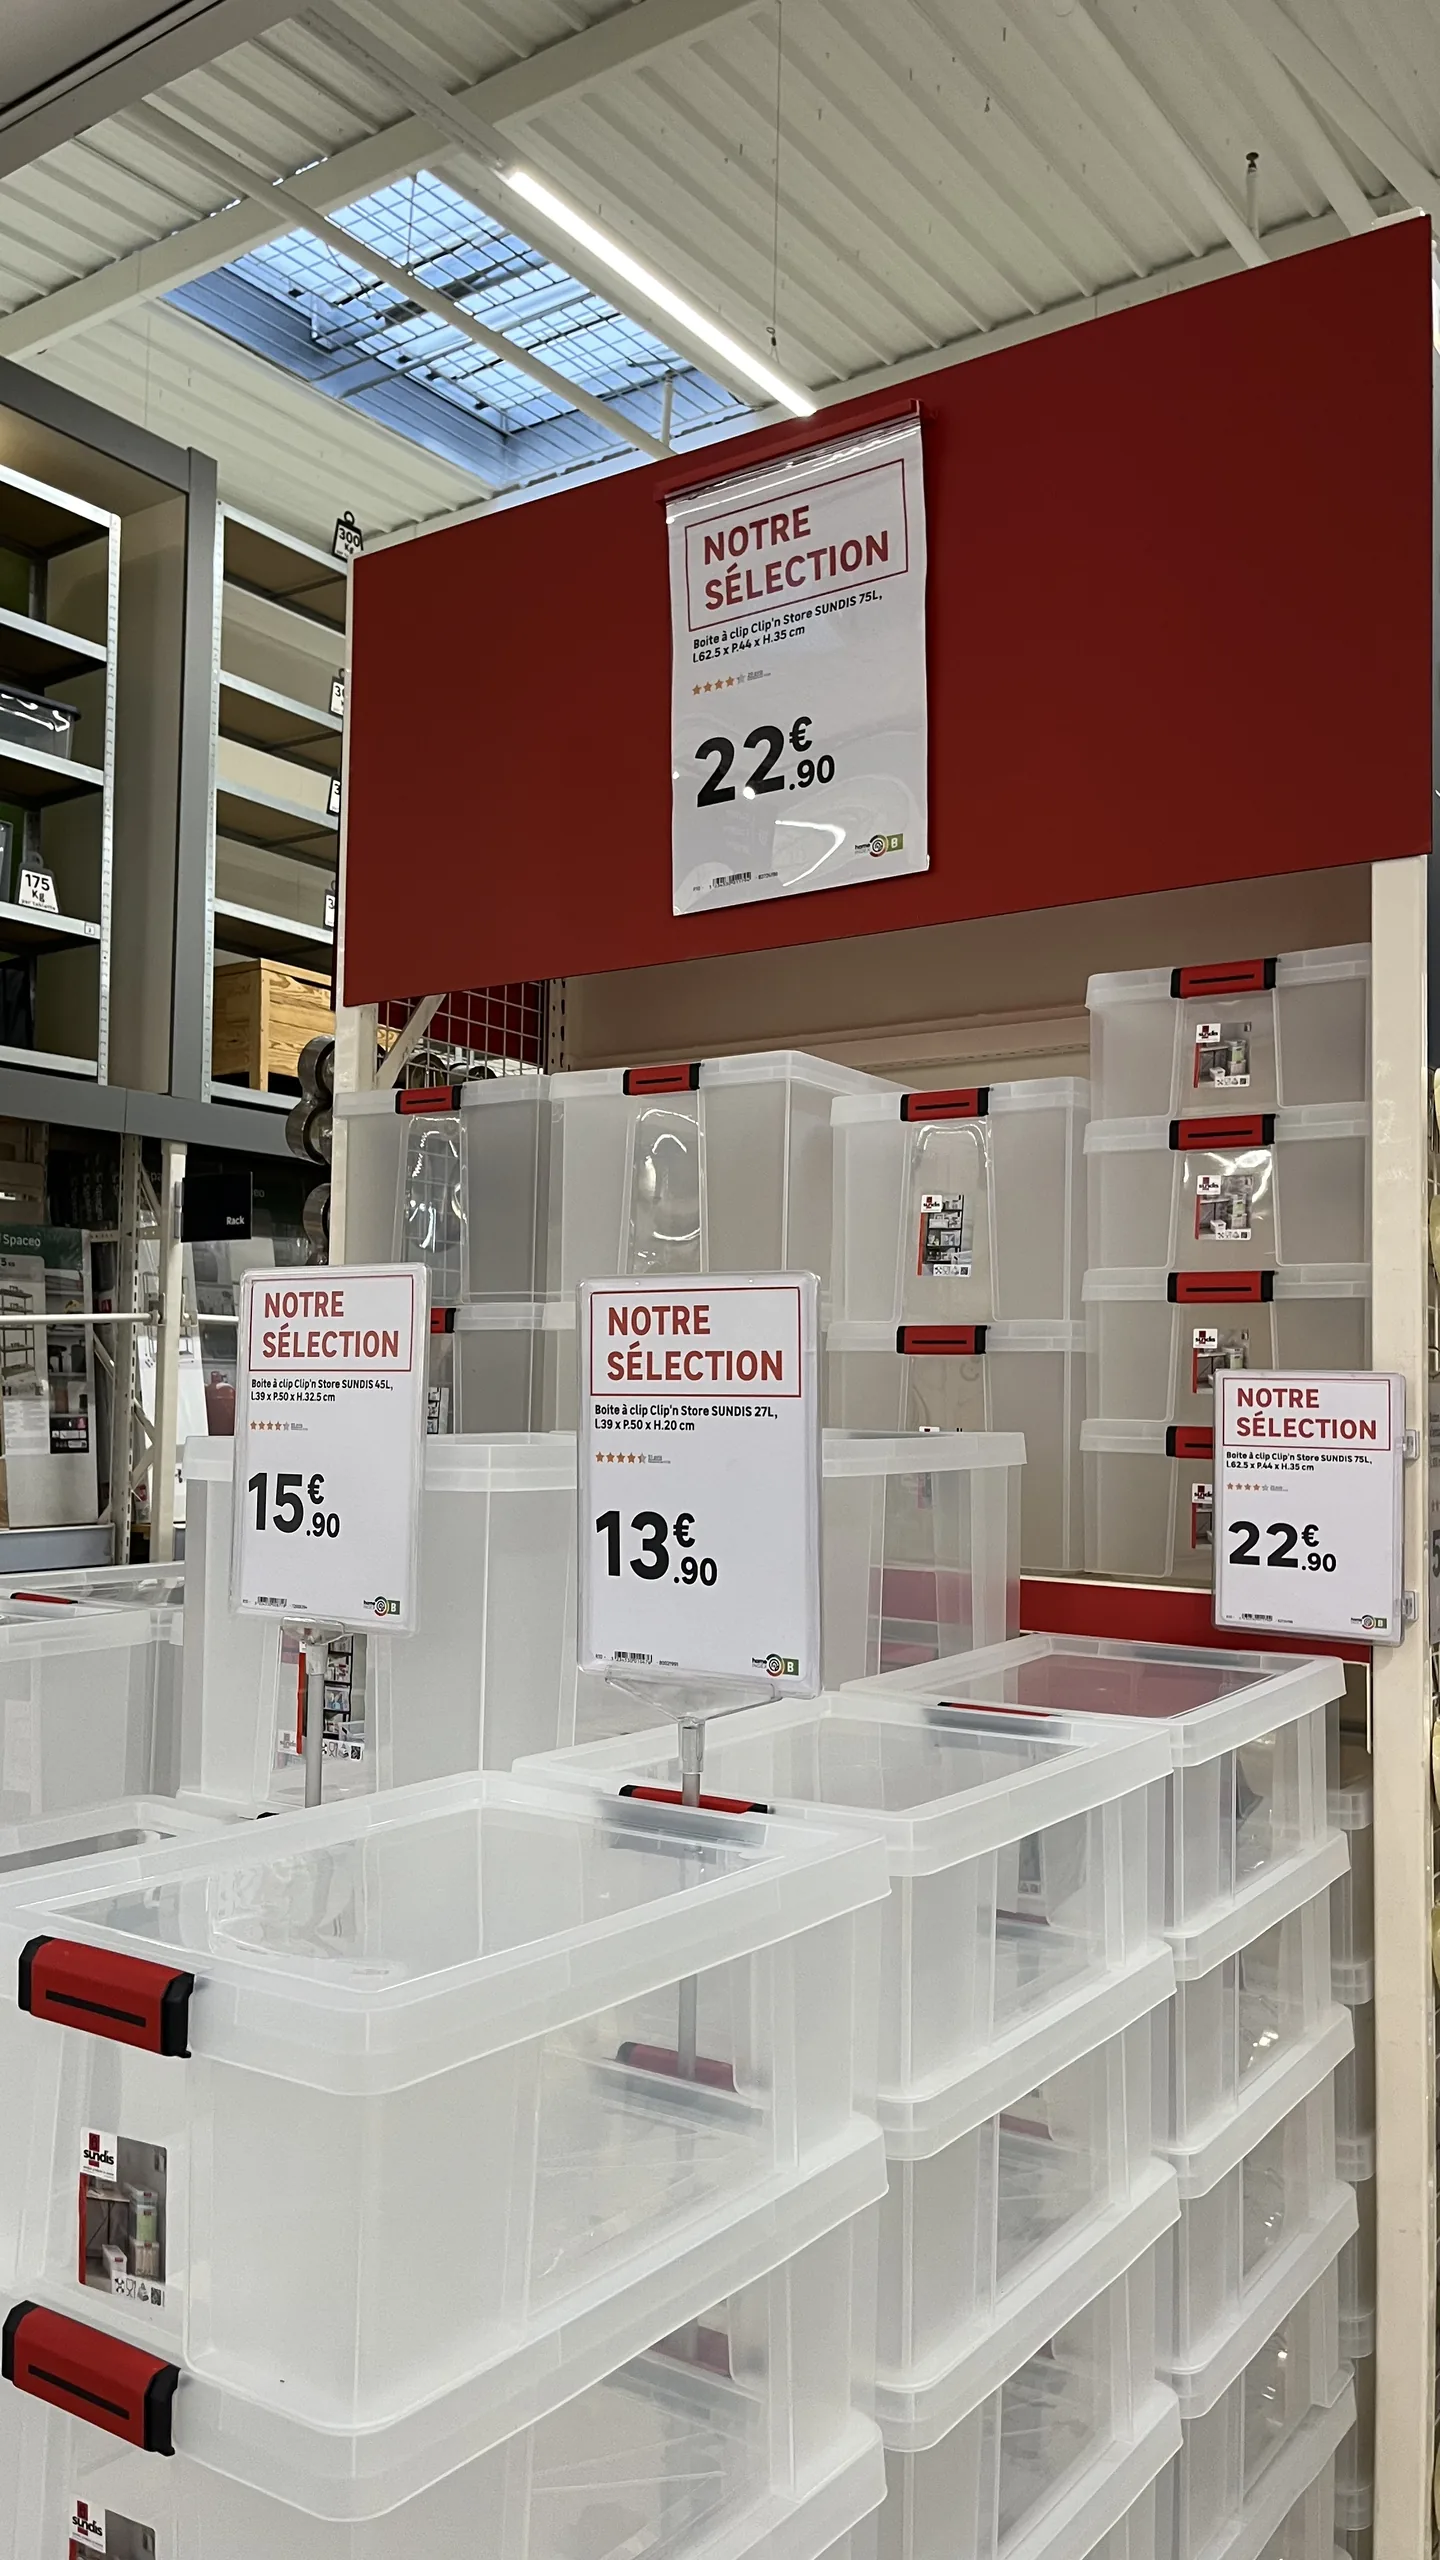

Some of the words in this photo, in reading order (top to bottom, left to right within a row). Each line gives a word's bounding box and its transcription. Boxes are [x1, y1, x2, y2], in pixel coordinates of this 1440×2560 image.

[338, 527, 360, 547] 300
[704, 505, 811, 565] NOTRE
[705, 530, 889, 610] SÉLECTION
[693, 634, 720, 650] Boite
[721, 630, 728, 642] à
[730, 626, 749, 640] clip
[751, 618, 780, 634] Clip'n
[783, 610, 812, 626] Store
[814, 595, 857, 616] SUNDIS
[859, 589, 883, 604] 75L,
[722, 646, 730, 656] x
[731, 639, 752, 653] P.44
[753, 637, 761, 647] x
[762, 630, 787, 645] H.35
[789, 626, 805, 638] cm
[788, 755, 836, 791] .90
[25, 873, 50, 891] 175
[226, 1215, 245, 1225] Rack
[264, 1290, 344, 1318] NOTRE
[608, 1304, 711, 1336] NOTRE
[262, 1322, 399, 1358] SÉLECTION
[607, 1340, 783, 1381] SÉLECTION
[251, 1378, 272, 1389] Boite
[272, 1378, 278, 1389] à
[278, 1379, 294, 1390] clip
[294, 1379, 317, 1391] Clip'n
[318, 1379, 341, 1389] Store
[341, 1379, 374, 1390] SUNDIS
[375, 1379, 394, 1391] 45L,
[266, 1393, 272, 1401] x
[273, 1391, 289, 1401] P.50
[290, 1393, 295, 1402] x
[296, 1392, 322, 1402] H.32.5
[323, 1393, 336, 1402] cm
[1237, 1387, 1319, 1409] NOTRE
[594, 1403, 620, 1415] Boite
[621, 1403, 628, 1415] à
[629, 1403, 648, 1418] clip
[650, 1404, 679, 1418] Clip'n
[680, 1405, 709, 1417] Store
[711, 1405, 752, 1418] SUNDIS
[754, 1406, 778, 1419] 27L,
[615, 1421, 621, 1430] x
[623, 1419, 643, 1430] P.50
[645, 1421, 652, 1430] x
[653, 1419, 677, 1431] H.20
[679, 1421, 695, 1431] cm
[1236, 1411, 1376, 1440] SÉLECTION
[1226, 1451, 1247, 1460] Boite
[1248, 1451, 1254, 1460] à
[1255, 1452, 1271, 1461] clip
[1271, 1452, 1295, 1462] Clip'n
[1296, 1453, 1320, 1462] Store
[1320, 1454, 1353, 1463] SUNDIS
[1281, 1463, 1300, 1471] H.35
[306, 1511, 340, 1538] .90
[673, 1556, 718, 1587] .90
[1301, 1552, 1337, 1572] .90
[83, 2149, 115, 2165] sundis
[72, 2515, 103, 2537] sundis
